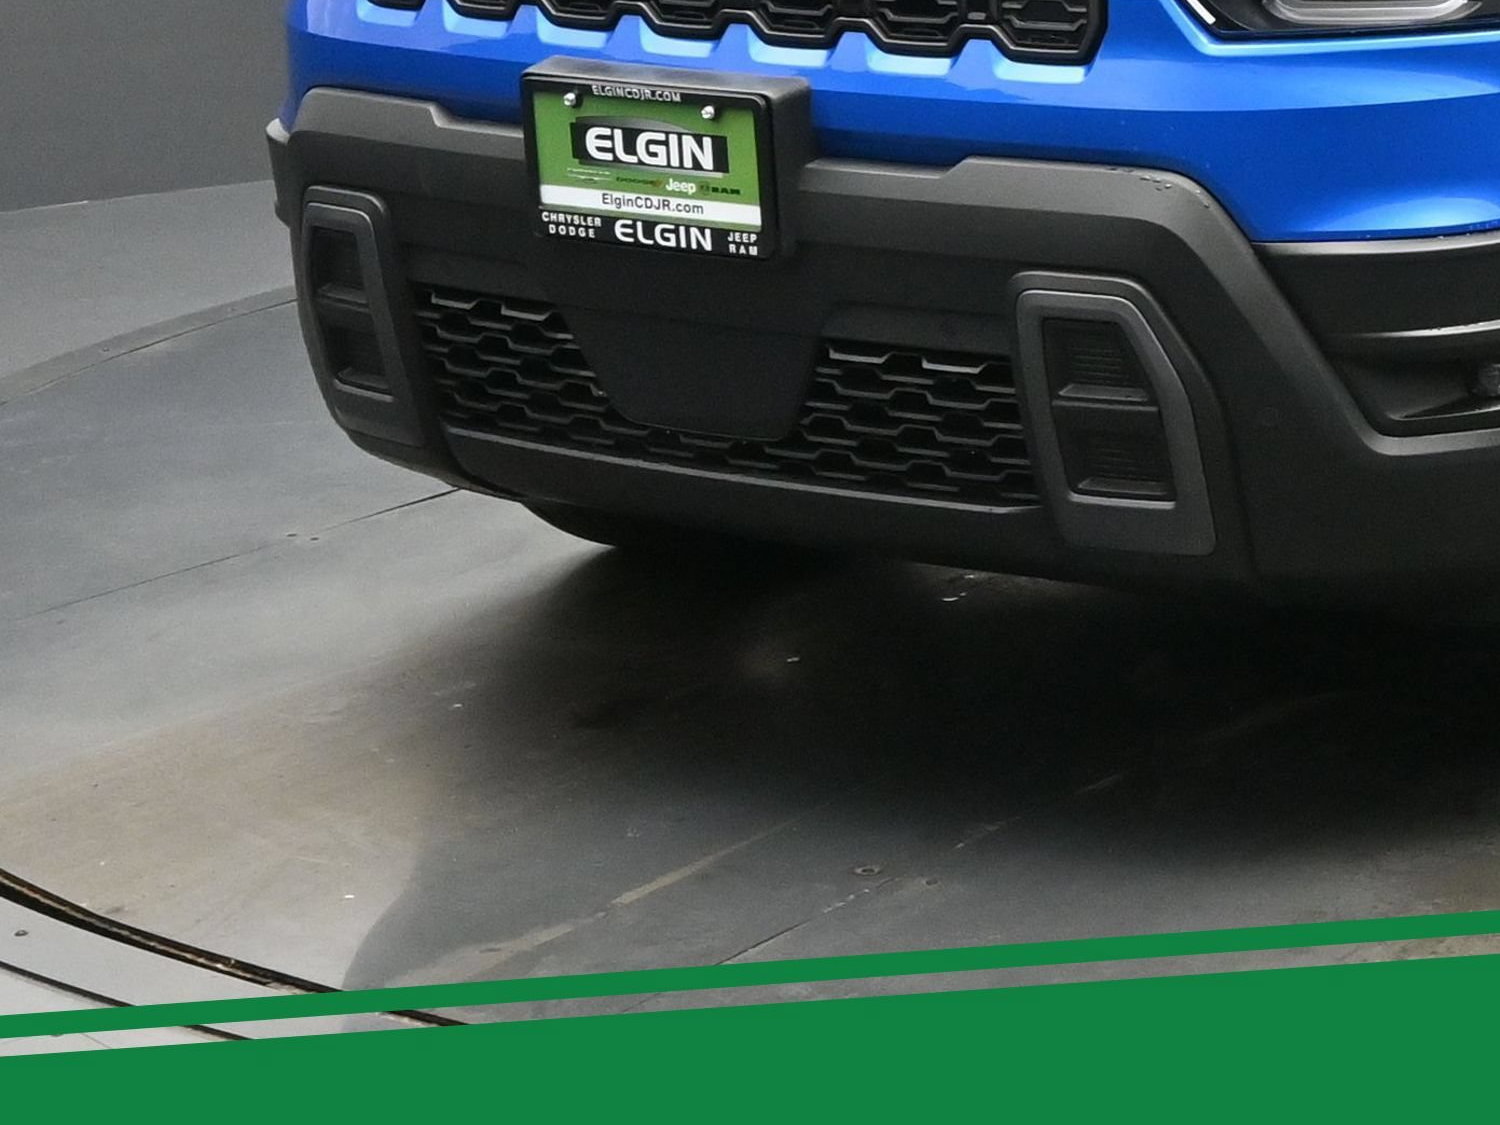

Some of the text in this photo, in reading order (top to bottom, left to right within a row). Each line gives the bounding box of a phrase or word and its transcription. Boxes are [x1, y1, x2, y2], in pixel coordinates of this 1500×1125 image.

[592, 84, 682, 103] ELGINCDJR.COM
[585, 126, 714, 170] ELGIN
[665, 178, 696, 196] Jeep
[601, 192, 704, 215] ElginCDJR.com
[541, 210, 602, 228] CHRYSLER
[549, 224, 596, 239] DODGE
[614, 219, 713, 252] ELGIN
[727, 231, 758, 243] JEEP
[728, 244, 759, 256] RAM
